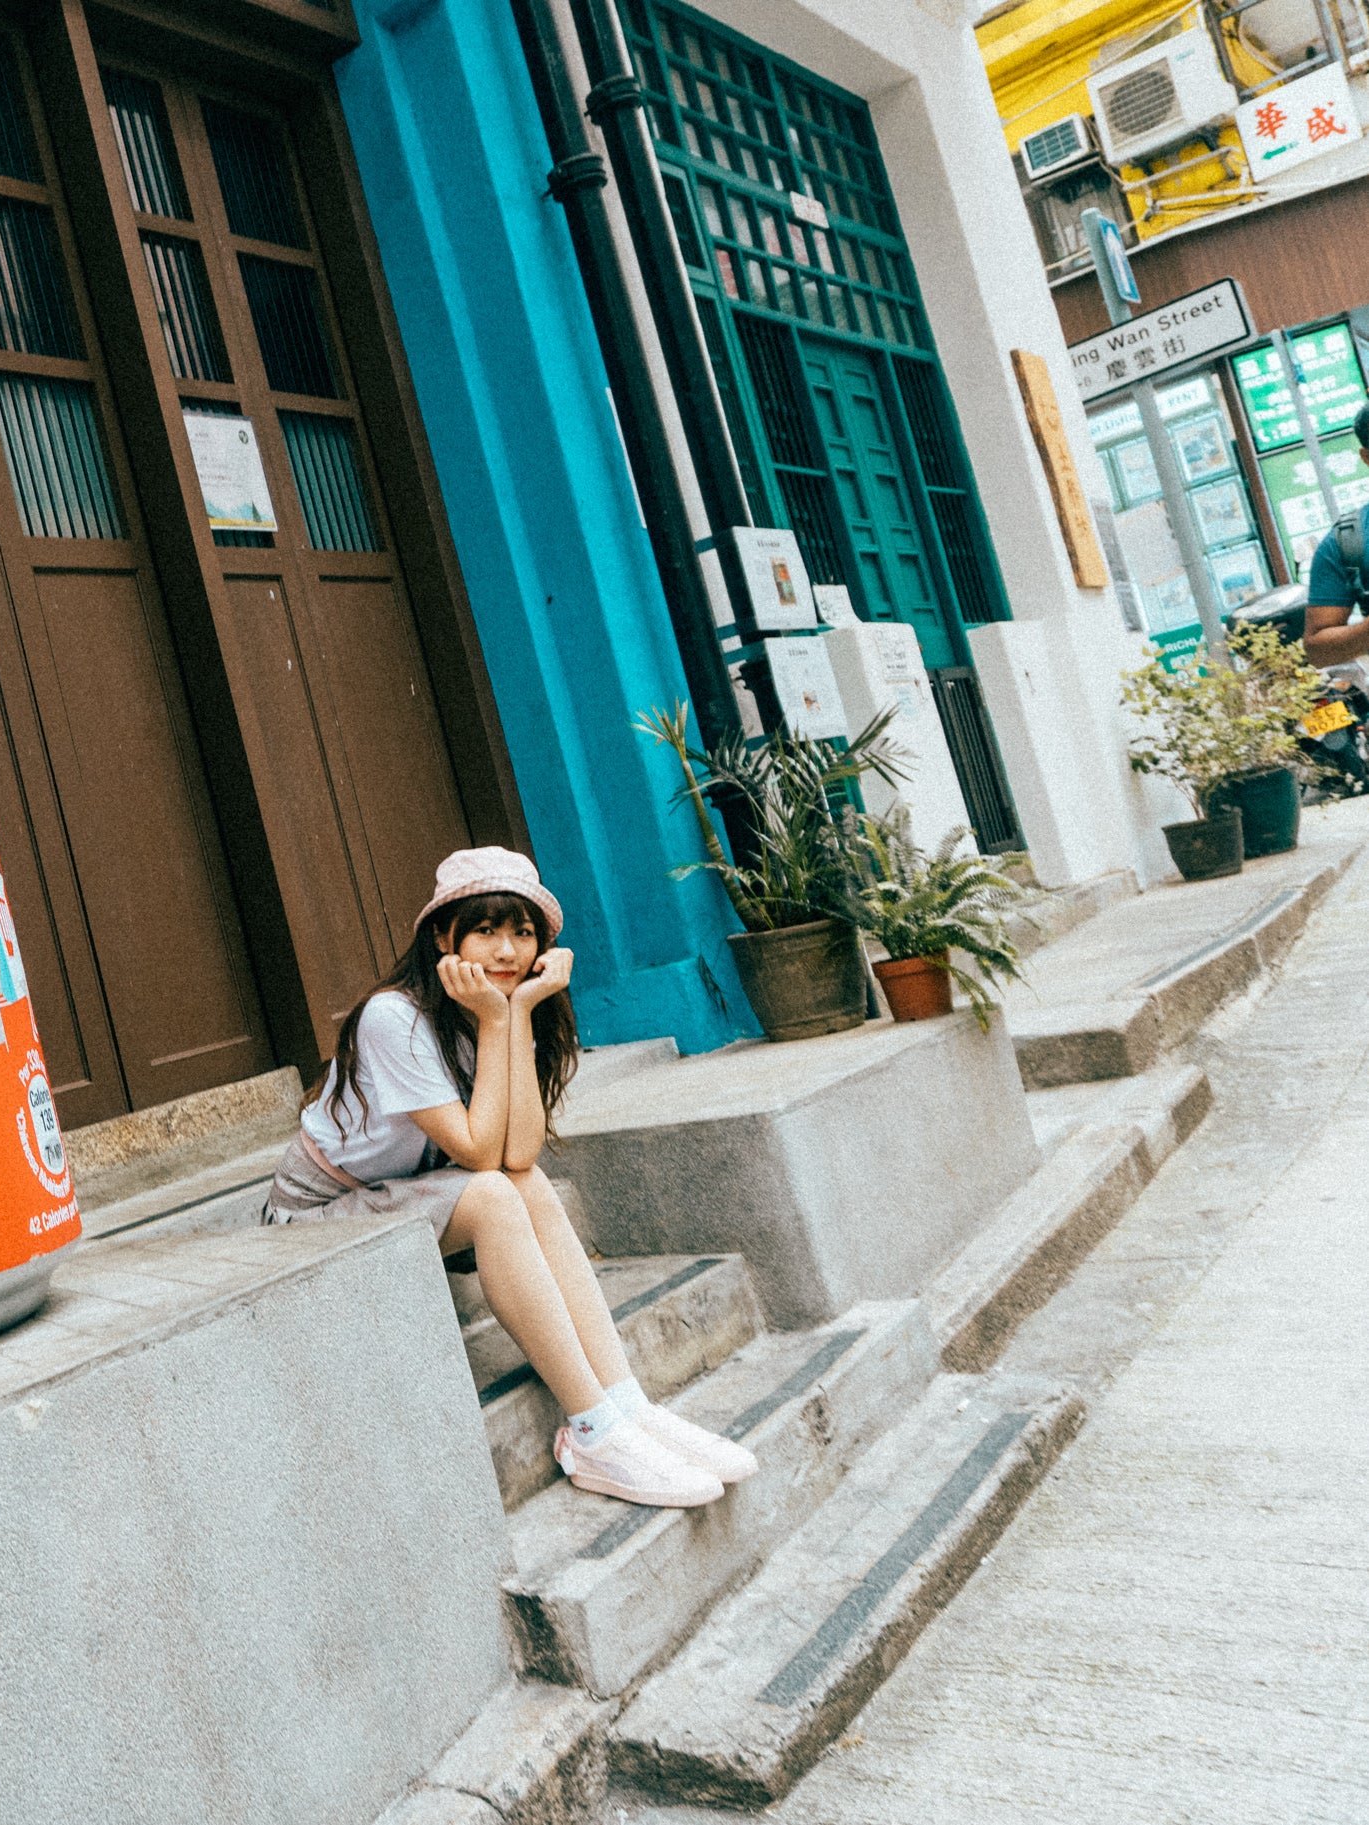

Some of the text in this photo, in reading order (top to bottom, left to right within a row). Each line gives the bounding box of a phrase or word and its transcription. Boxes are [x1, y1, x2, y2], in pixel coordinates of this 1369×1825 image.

[1071, 294, 1223, 368] ing Wan Street
[1106, 335, 1186, 382] 慶雲街
[29, 1215, 43, 1236] 42
[41, 1204, 70, 1232] Calories
